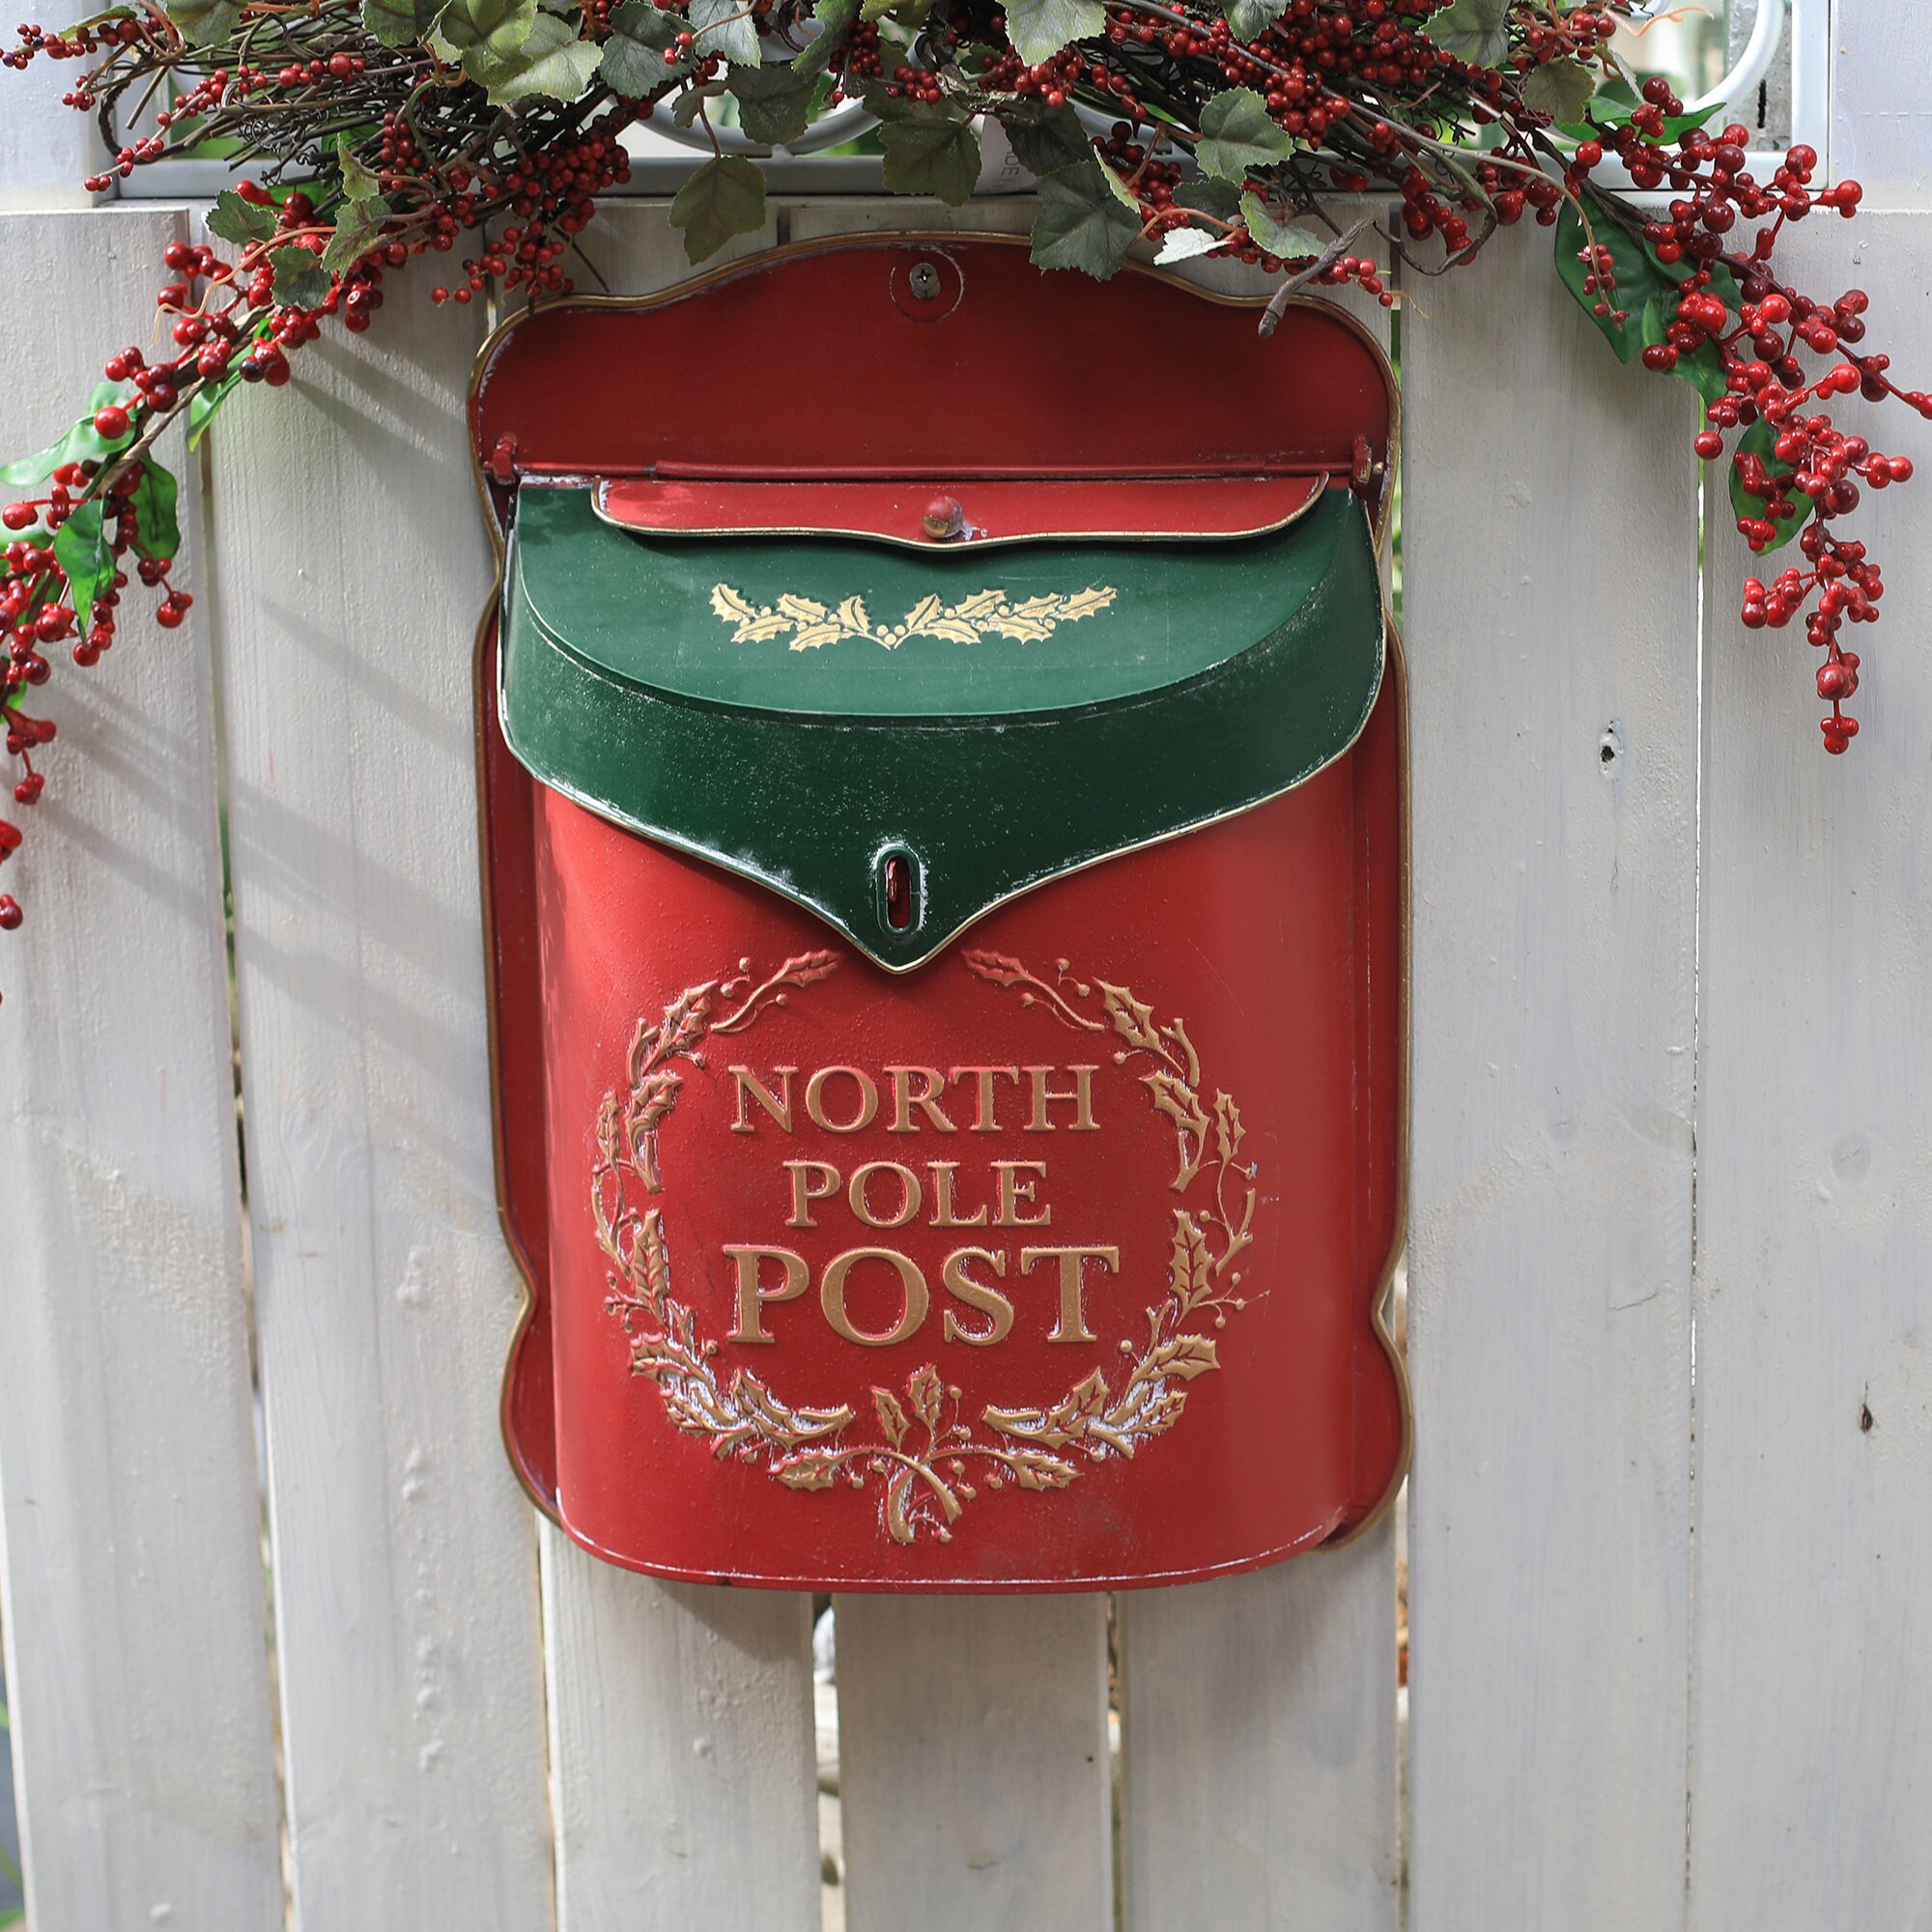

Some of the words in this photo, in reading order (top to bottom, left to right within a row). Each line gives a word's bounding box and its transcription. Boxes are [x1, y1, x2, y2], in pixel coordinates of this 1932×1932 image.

[727, 1064, 1102, 1134] NORTH
[782, 1158, 1052, 1229] POLE
[722, 1243, 1121, 1347] POST
